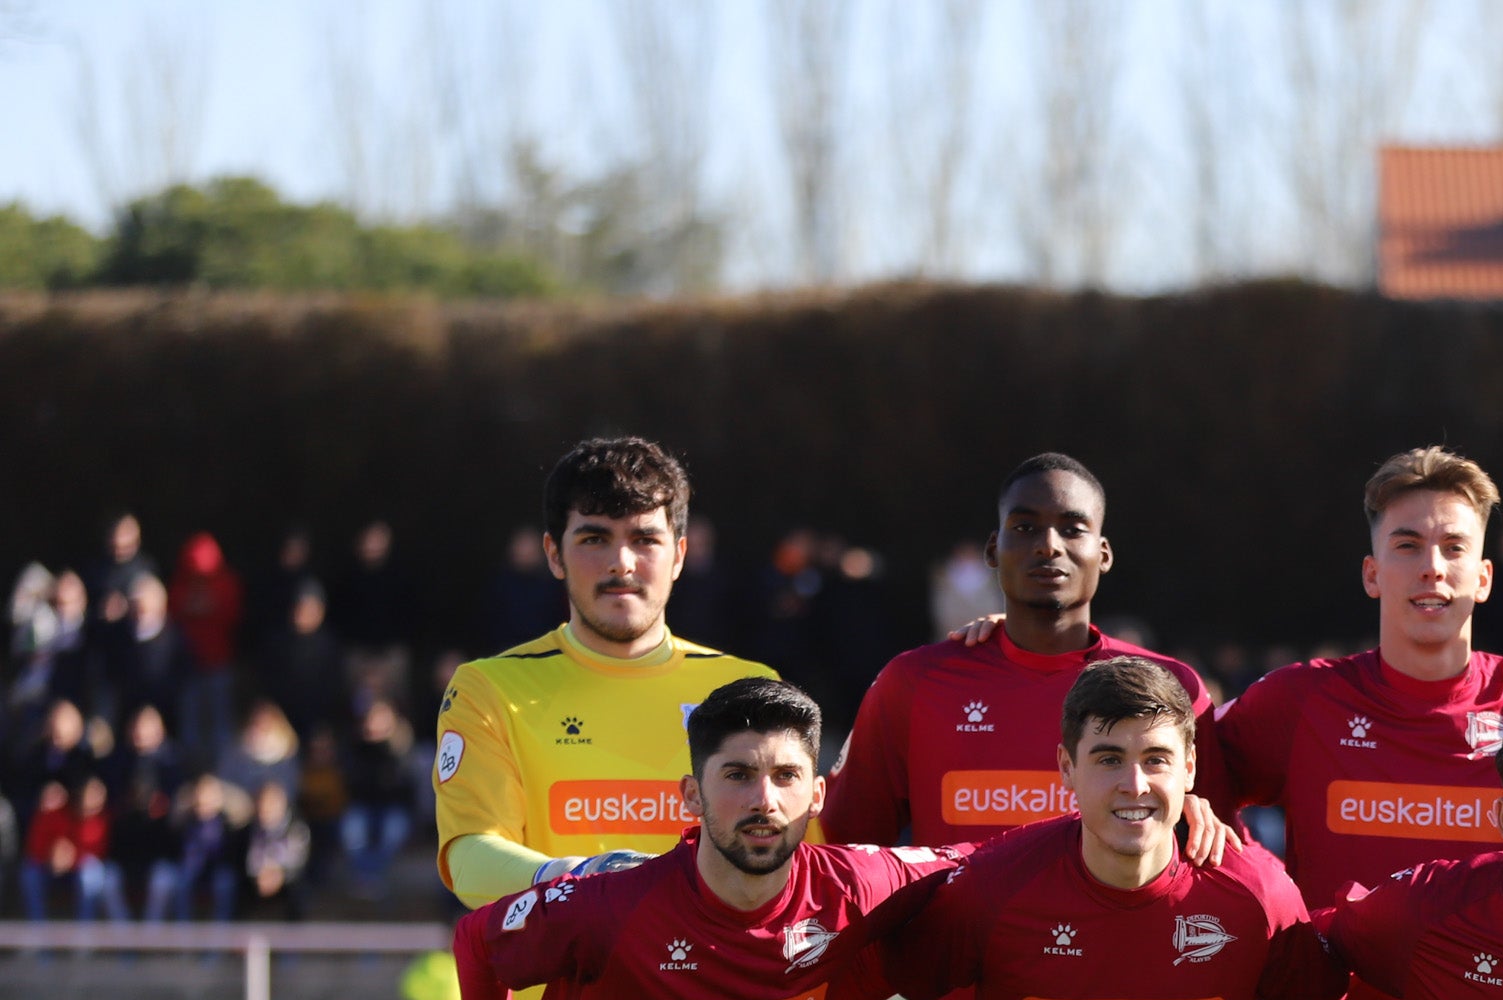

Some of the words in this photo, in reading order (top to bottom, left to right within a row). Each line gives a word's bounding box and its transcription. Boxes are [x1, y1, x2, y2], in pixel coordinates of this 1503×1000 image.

[955, 724, 994, 732] KELME
[1340, 738, 1377, 749] KELME
[1340, 796, 1481, 828] euskaltel
[1043, 946, 1083, 957] KELME
[659, 963, 698, 971] KELME
[1464, 971, 1503, 986] KELME
